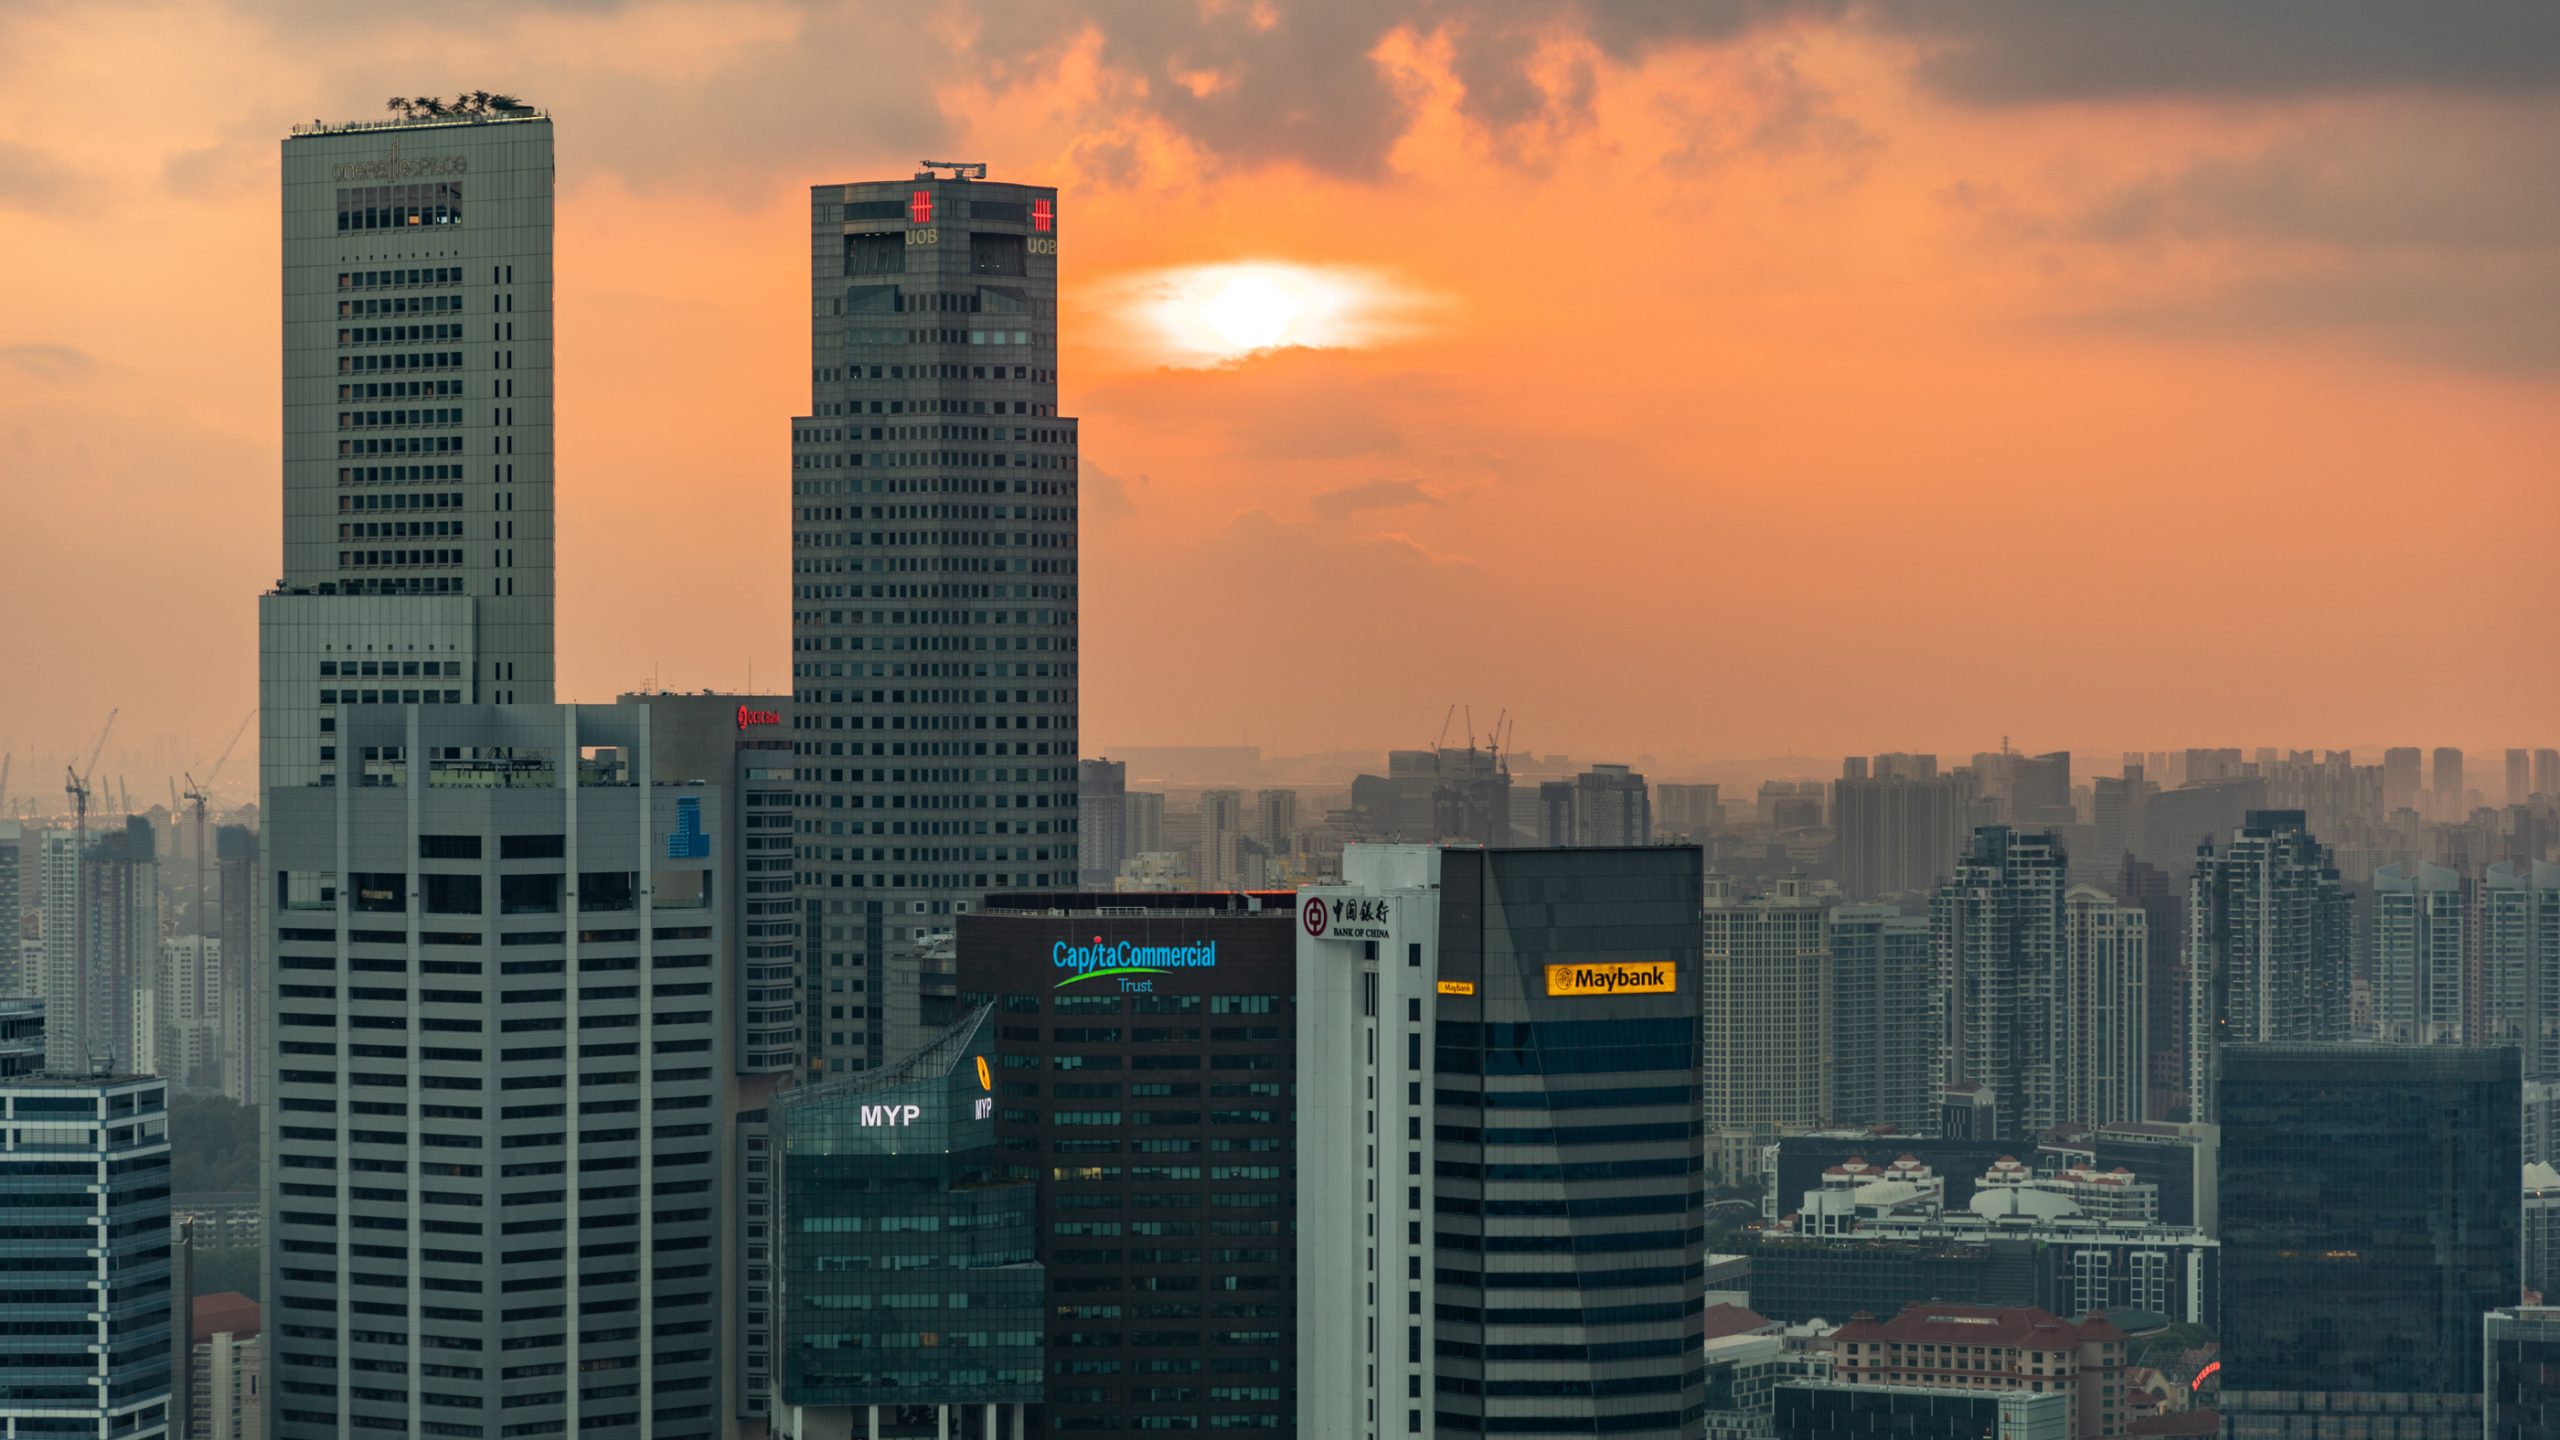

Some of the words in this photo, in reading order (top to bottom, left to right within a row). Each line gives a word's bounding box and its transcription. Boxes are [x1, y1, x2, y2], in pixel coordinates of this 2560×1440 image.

[905, 228, 938, 245] UOB
[1028, 238, 1057, 254] UOB
[1334, 928, 1354, 937] BANK
[1355, 928, 1365, 937] OF
[1366, 929, 1389, 938] CHINA
[1053, 936, 1216, 974] CapitaCommercial
[1118, 978, 1153, 993] Trust
[1575, 966, 1664, 991] Maybank
[861, 1105, 920, 1126] MYP
[975, 1098, 992, 1120] MYP
